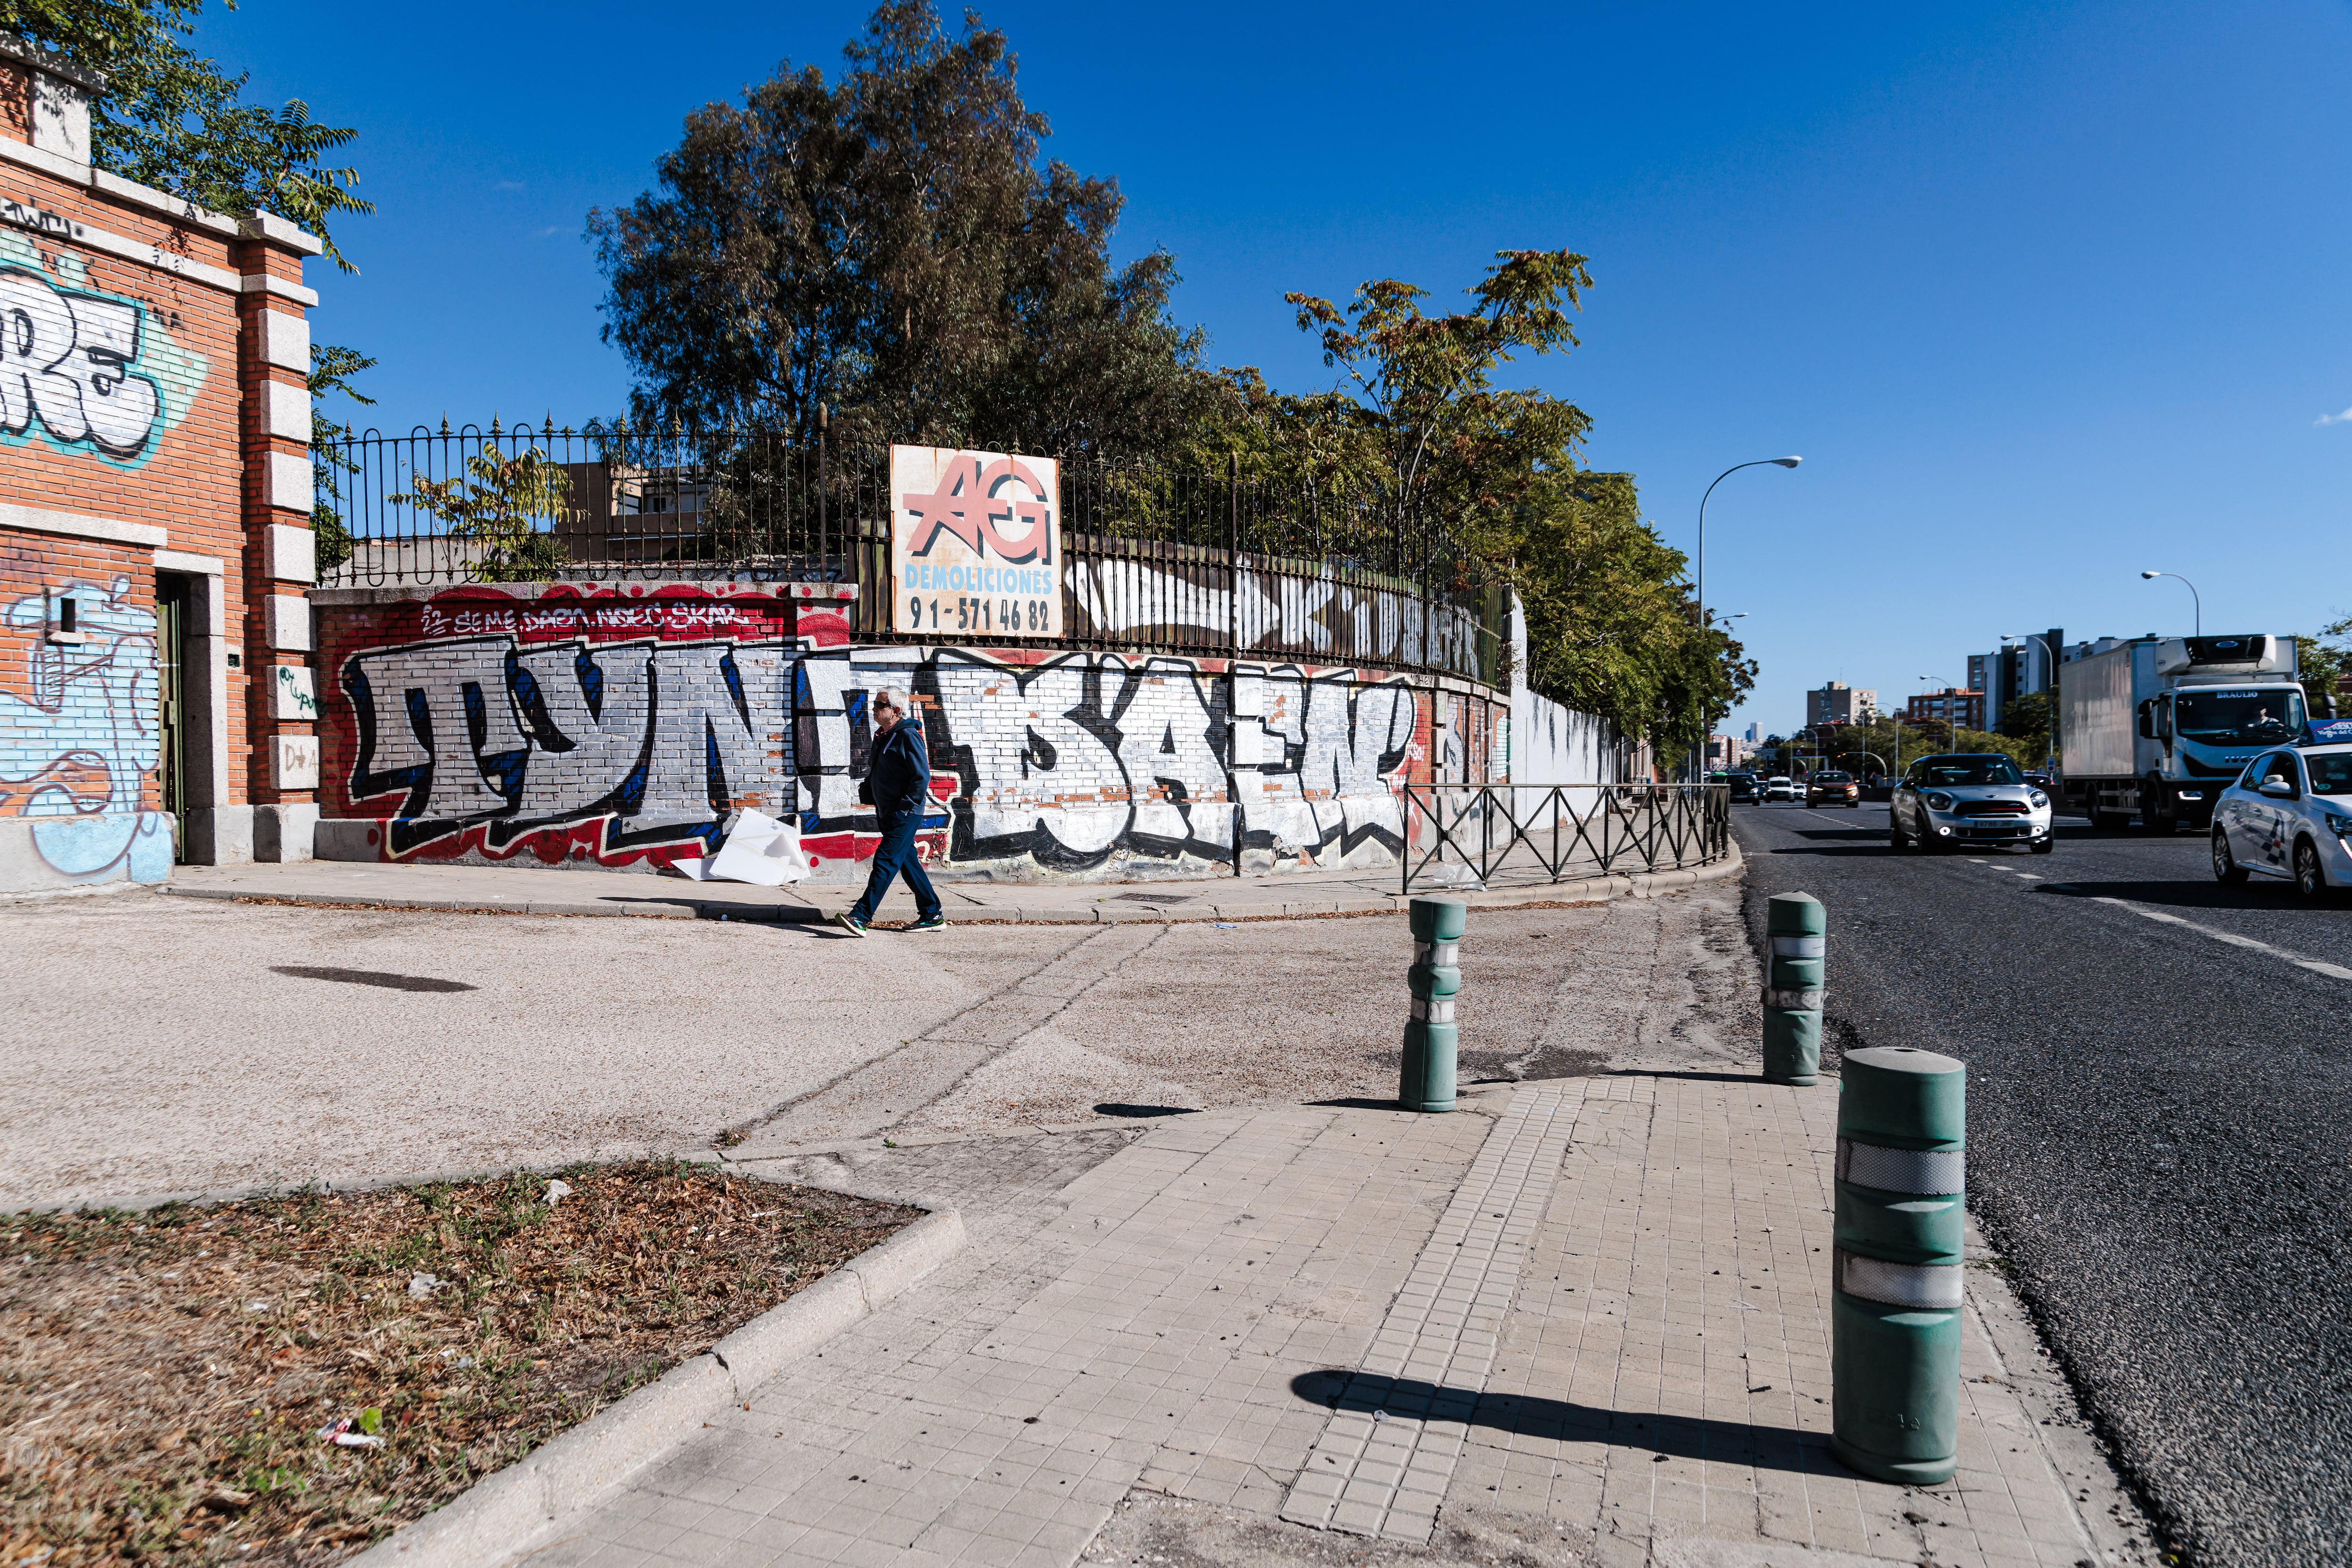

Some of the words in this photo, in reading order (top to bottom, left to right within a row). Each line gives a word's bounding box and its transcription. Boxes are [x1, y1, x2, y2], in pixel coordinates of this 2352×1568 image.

[905, 563, 1052, 595] DEMOLICIONES
[999, 599, 1021, 632] 46
[1028, 599, 1049, 632] 82
